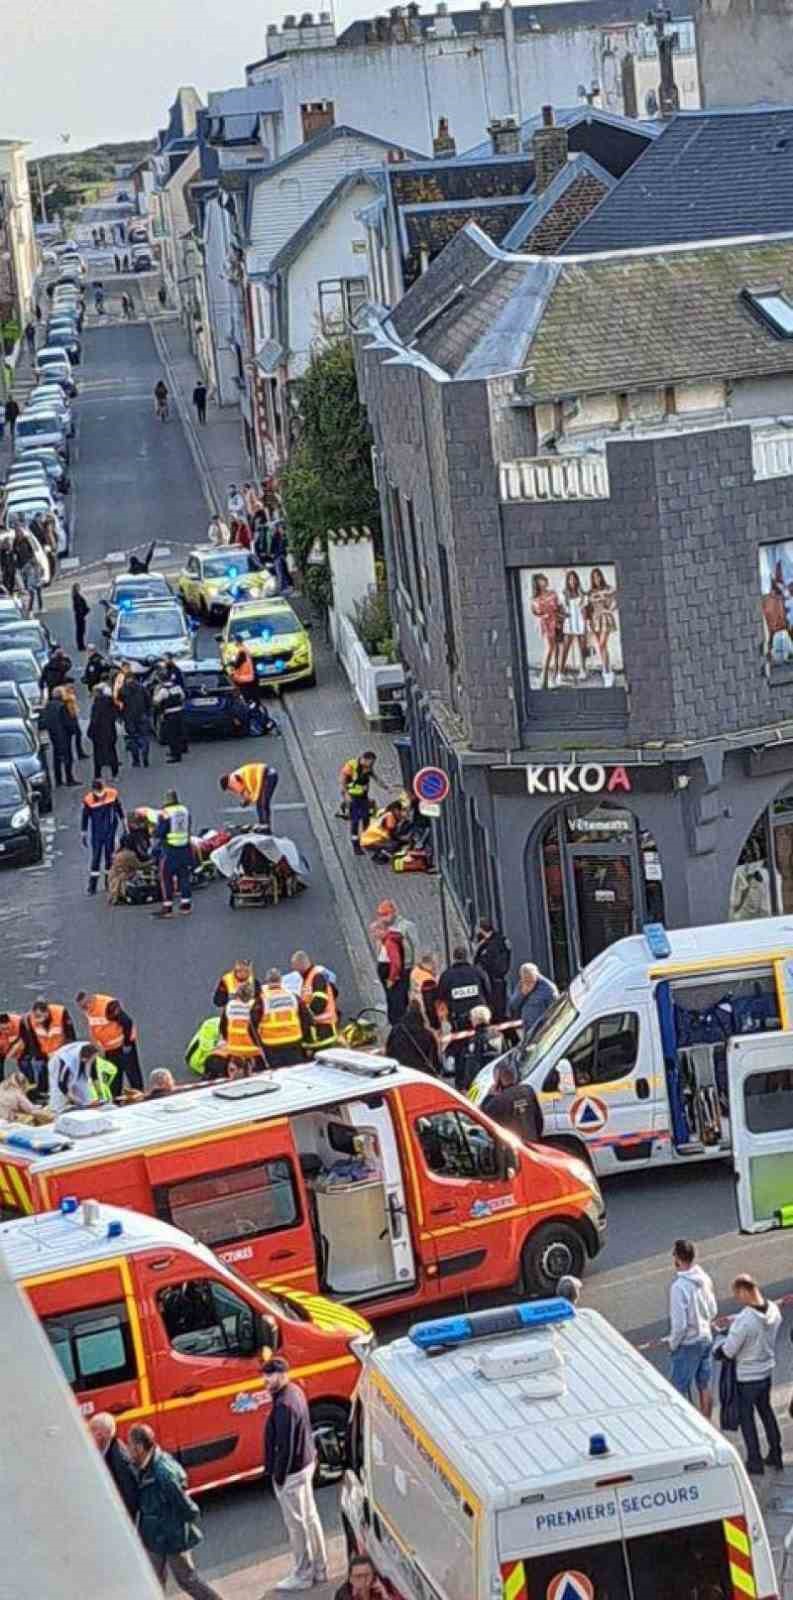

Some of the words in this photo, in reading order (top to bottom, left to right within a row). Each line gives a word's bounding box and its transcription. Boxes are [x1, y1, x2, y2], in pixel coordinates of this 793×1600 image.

[568, 817, 629, 831] Vêtements
[453, 986, 477, 998] POLICE
[536, 1502, 616, 1530] PREMIERS
[621, 1486, 699, 1513] SECOURS
